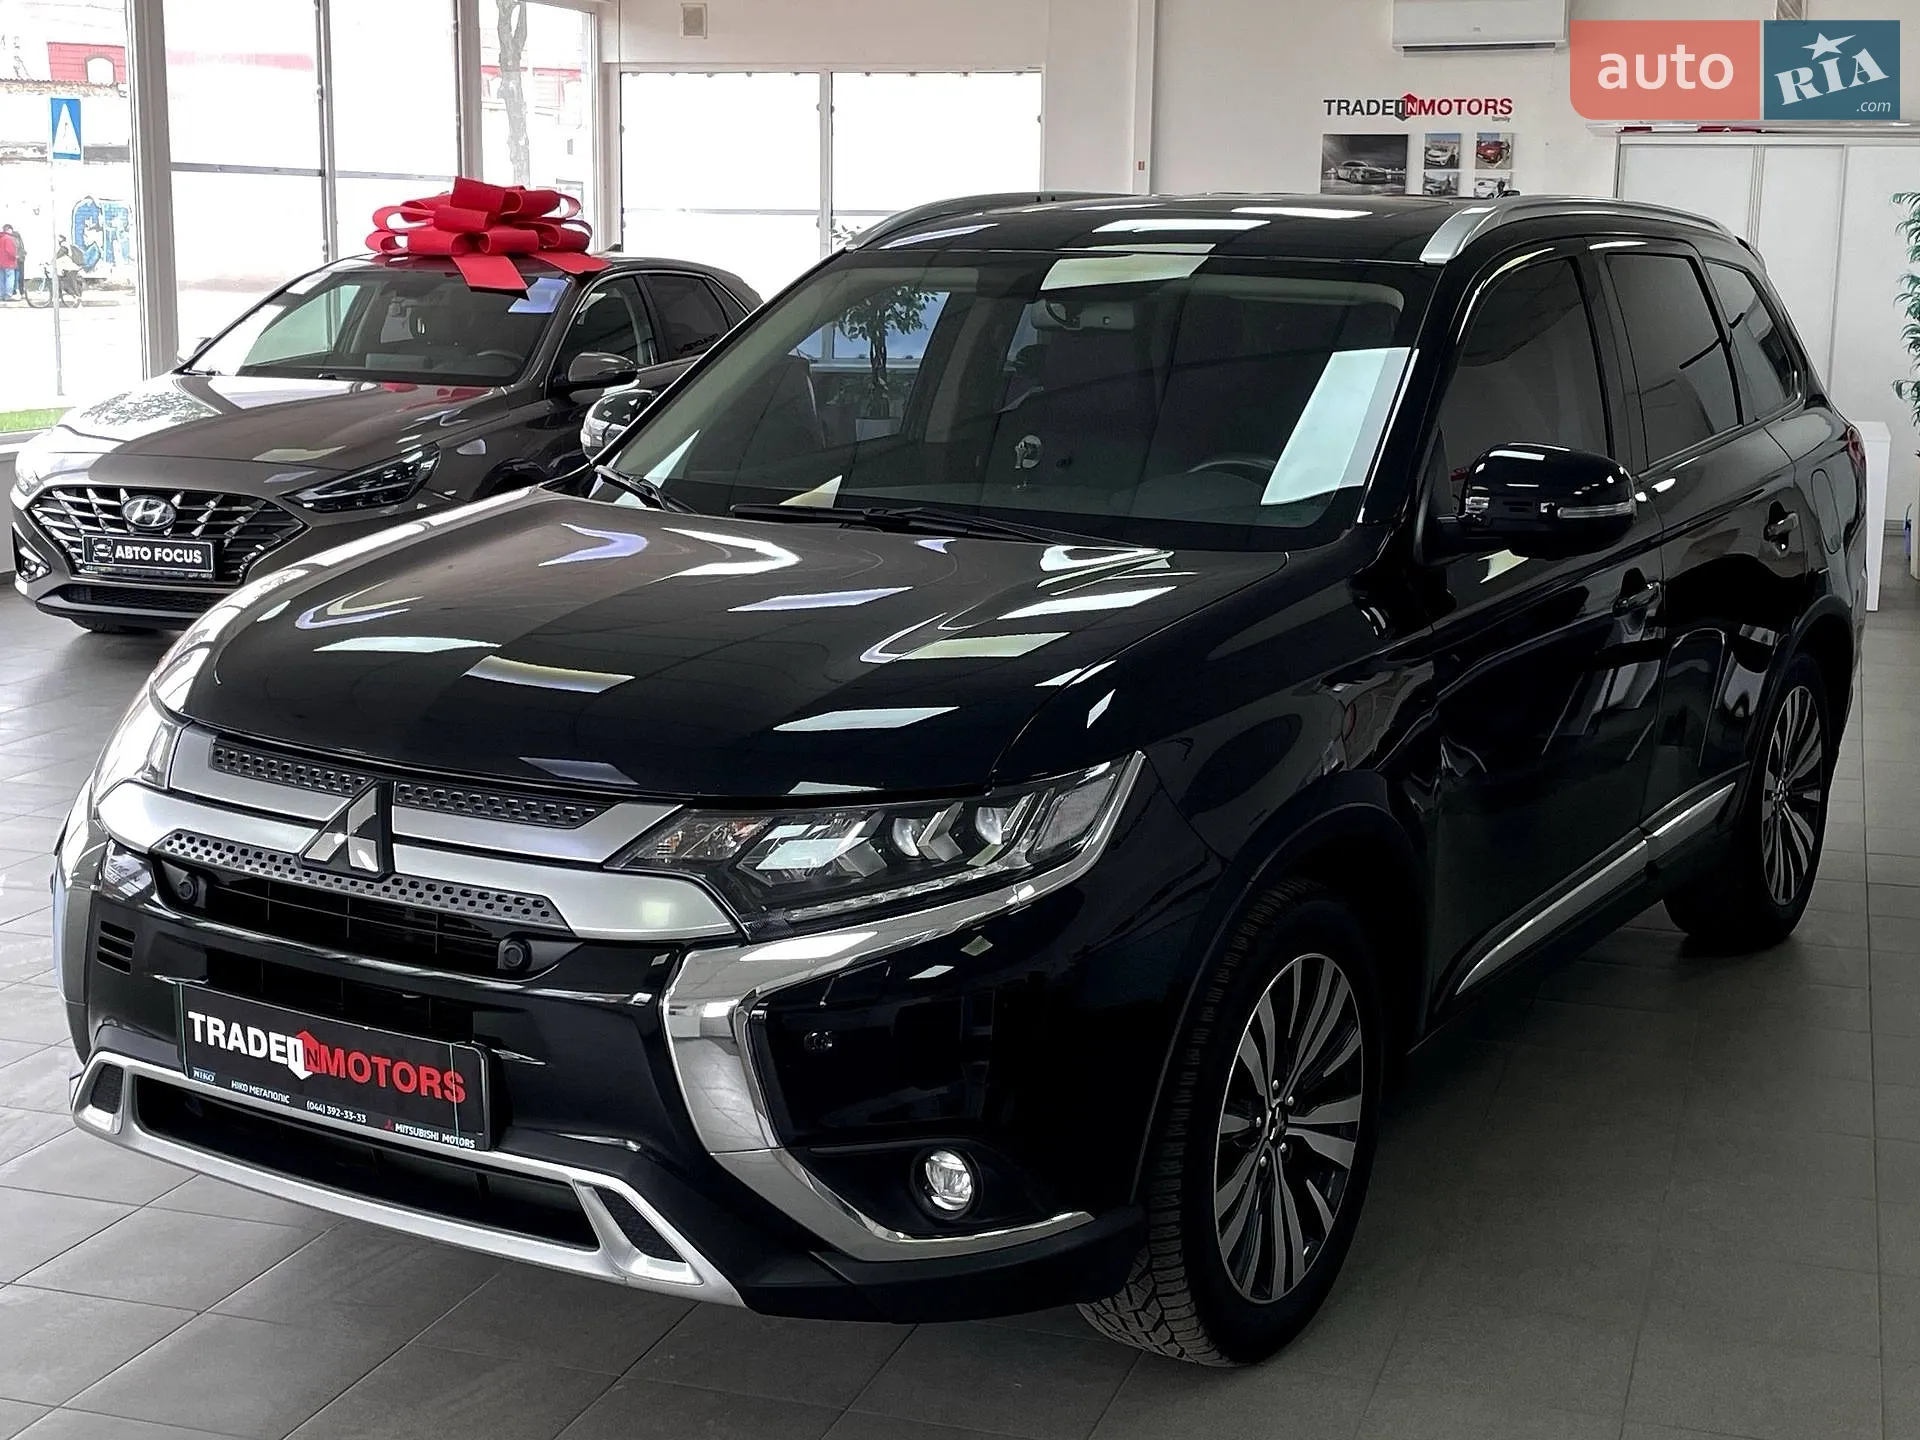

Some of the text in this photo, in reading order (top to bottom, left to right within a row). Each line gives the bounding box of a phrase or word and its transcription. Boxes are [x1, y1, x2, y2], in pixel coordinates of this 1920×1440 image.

[154, 546, 203, 564] FOCUS
[193, 1069, 215, 1083] NIKO
[306, 1099, 367, 1124] (044) 392-33-33
[394, 1122, 476, 1150] MITSUBISHI MOTORS
